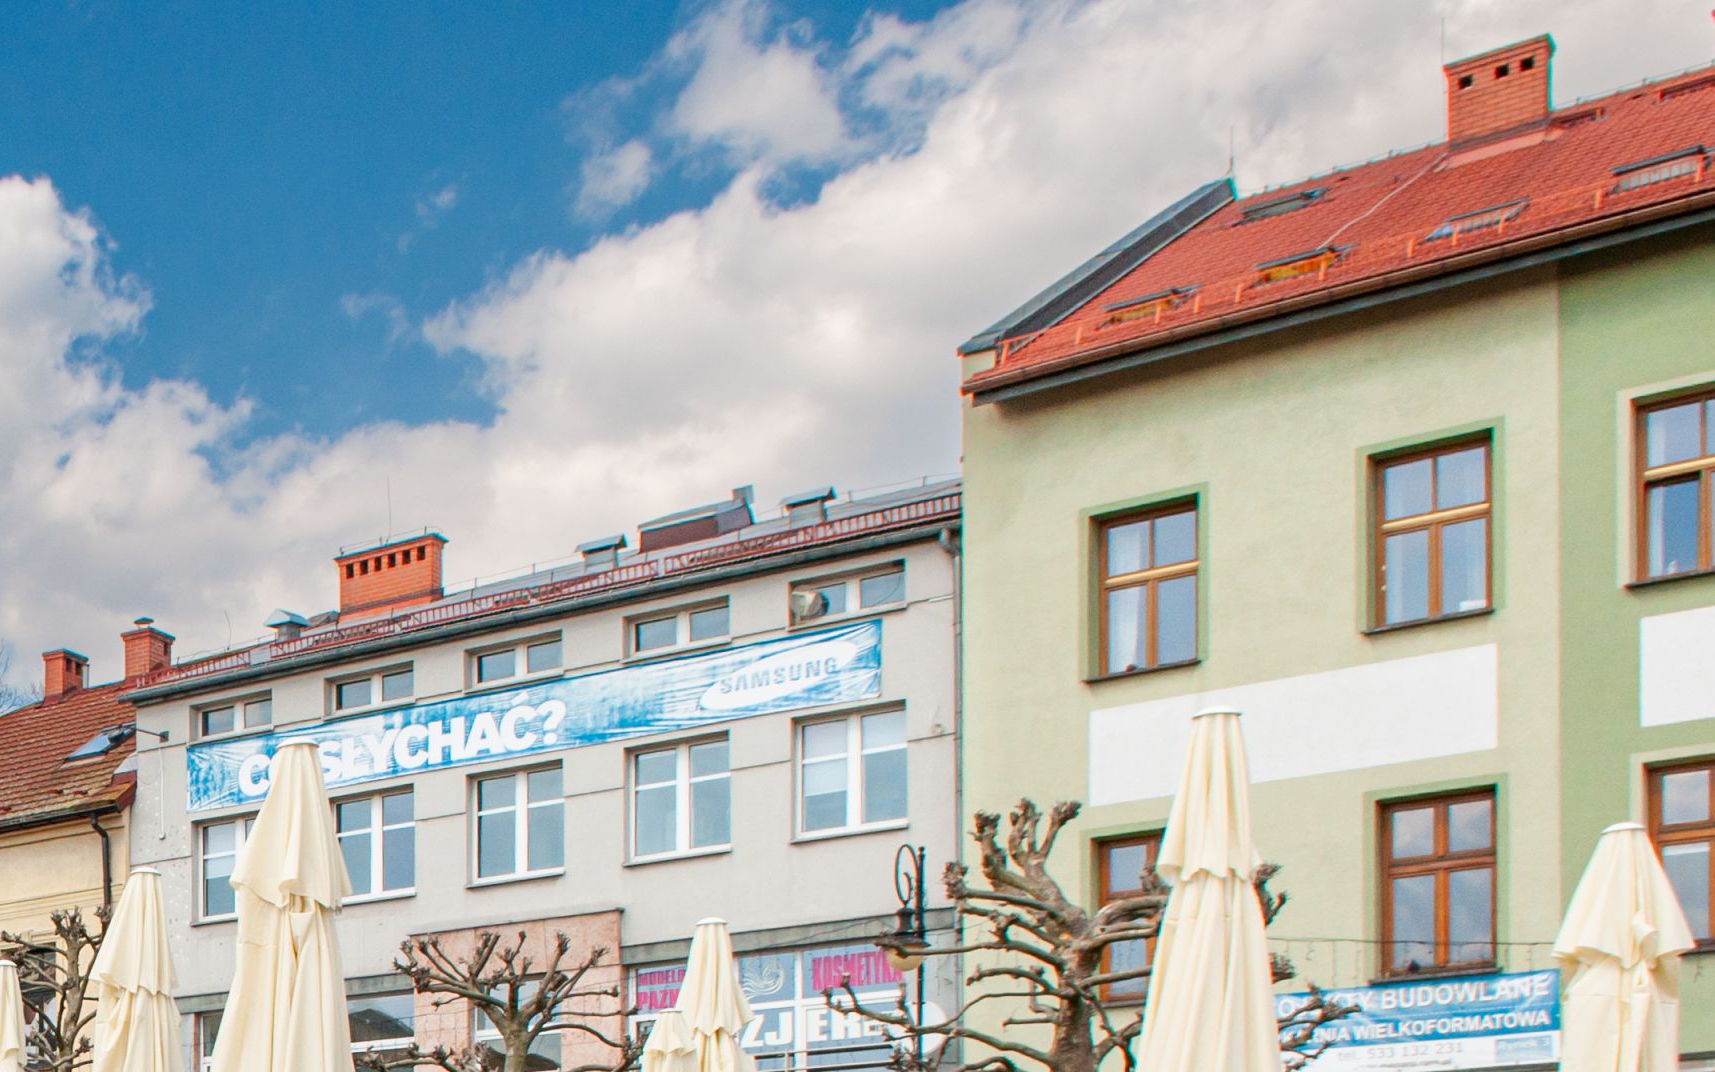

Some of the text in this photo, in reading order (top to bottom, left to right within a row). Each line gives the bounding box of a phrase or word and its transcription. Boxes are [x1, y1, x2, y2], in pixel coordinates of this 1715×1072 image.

[719, 656, 839, 695] SAMSUNG
[238, 691, 567, 797] C SŁYCHAĆ?
[1381, 973, 1551, 1010] BUDOWLANE
[1353, 1010, 1550, 1040] WIELKOFORMATOWA
[1368, 1047, 1395, 1059] 533
[1402, 1043, 1429, 1057] 132
[1435, 1041, 1464, 1055] 231
